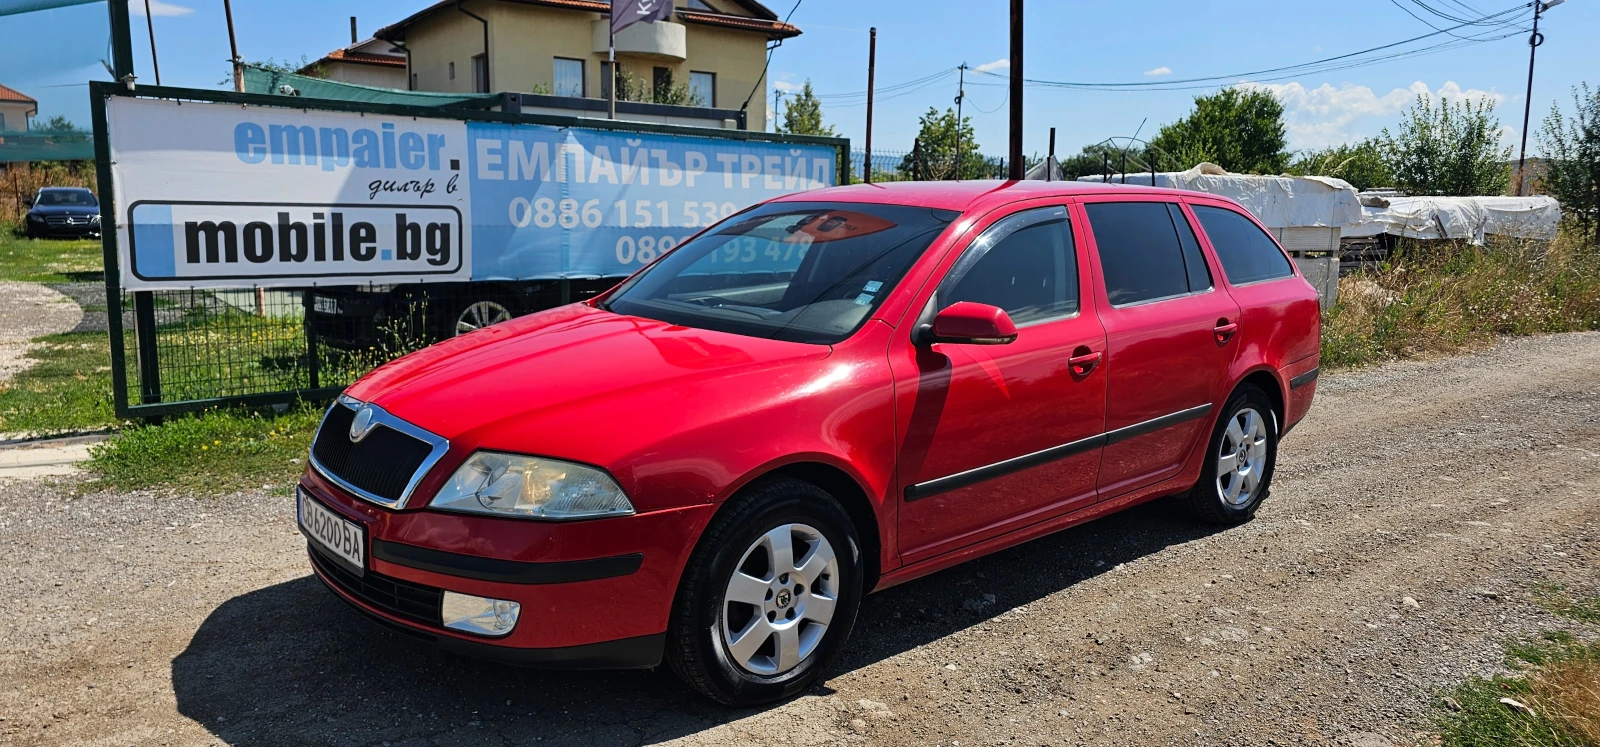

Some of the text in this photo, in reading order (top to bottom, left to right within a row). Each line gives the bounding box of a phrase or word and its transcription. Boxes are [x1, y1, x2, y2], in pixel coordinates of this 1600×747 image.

[475, 138, 833, 190] ЕМПАЙЪР ТРЕЙД
[368, 174, 459, 200] дилър в
[508, 196, 737, 229] 0886 151 539
[184, 212, 451, 266] mobile.bg
[615, 235, 692, 265] 089
